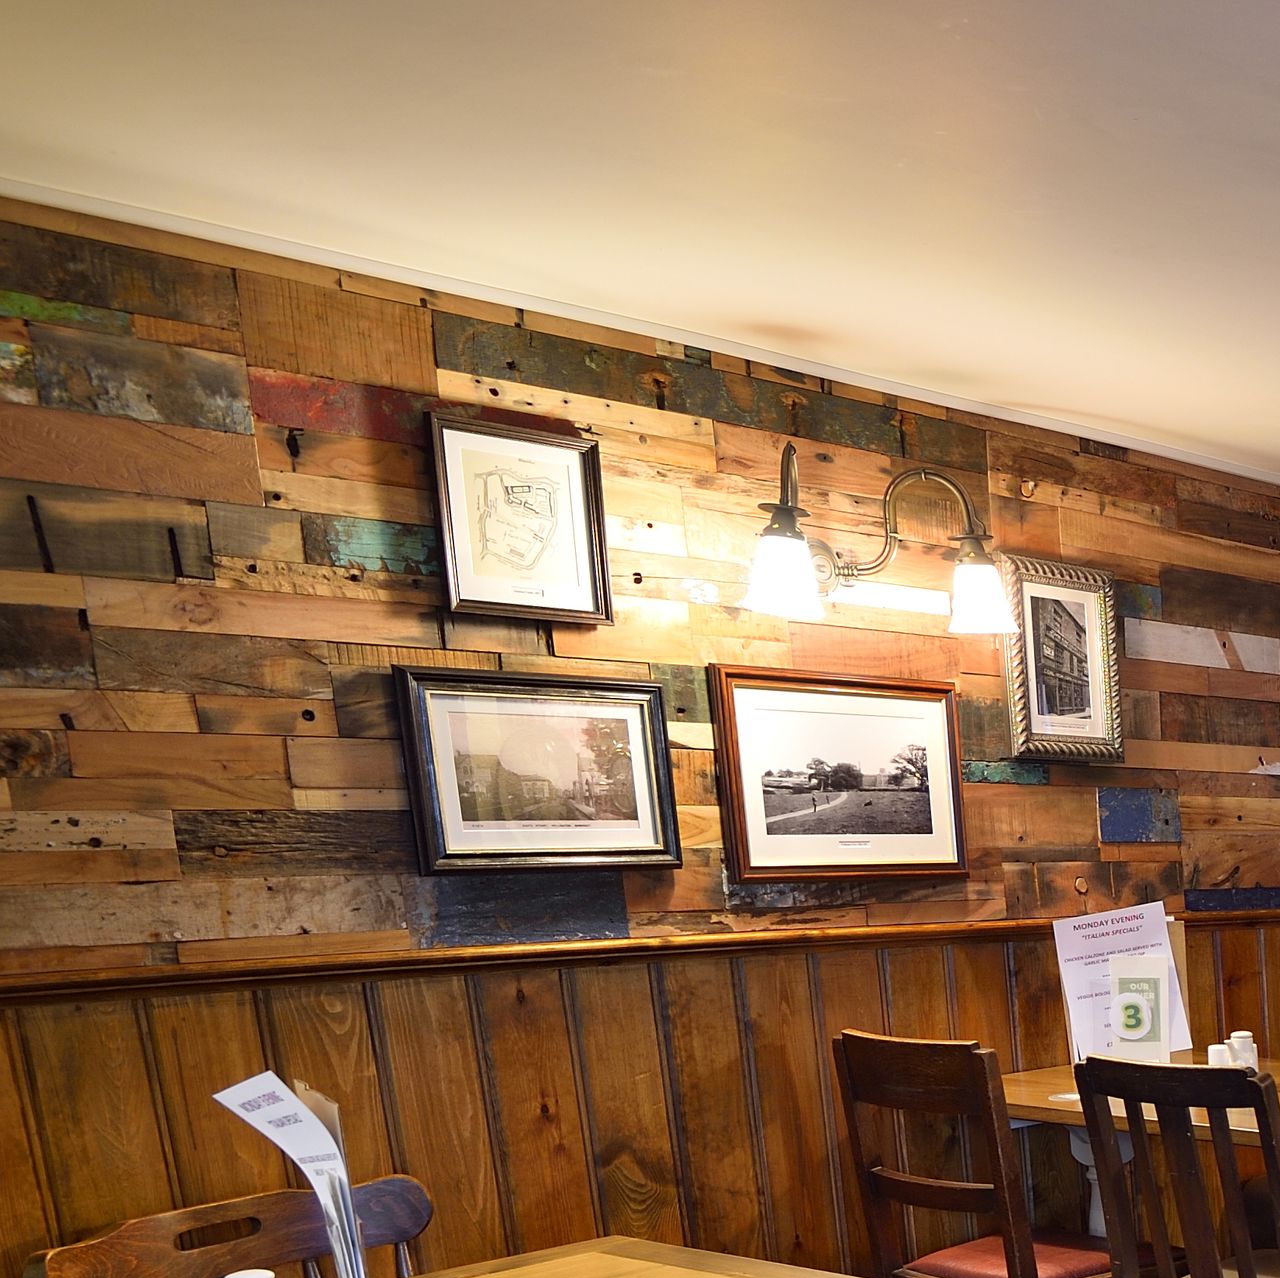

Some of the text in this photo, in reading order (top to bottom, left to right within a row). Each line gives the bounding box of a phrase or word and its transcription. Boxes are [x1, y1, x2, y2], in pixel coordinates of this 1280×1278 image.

[1073, 913, 1145, 932] MONDAY EVENING
[1124, 1004, 1142, 1029] 3
